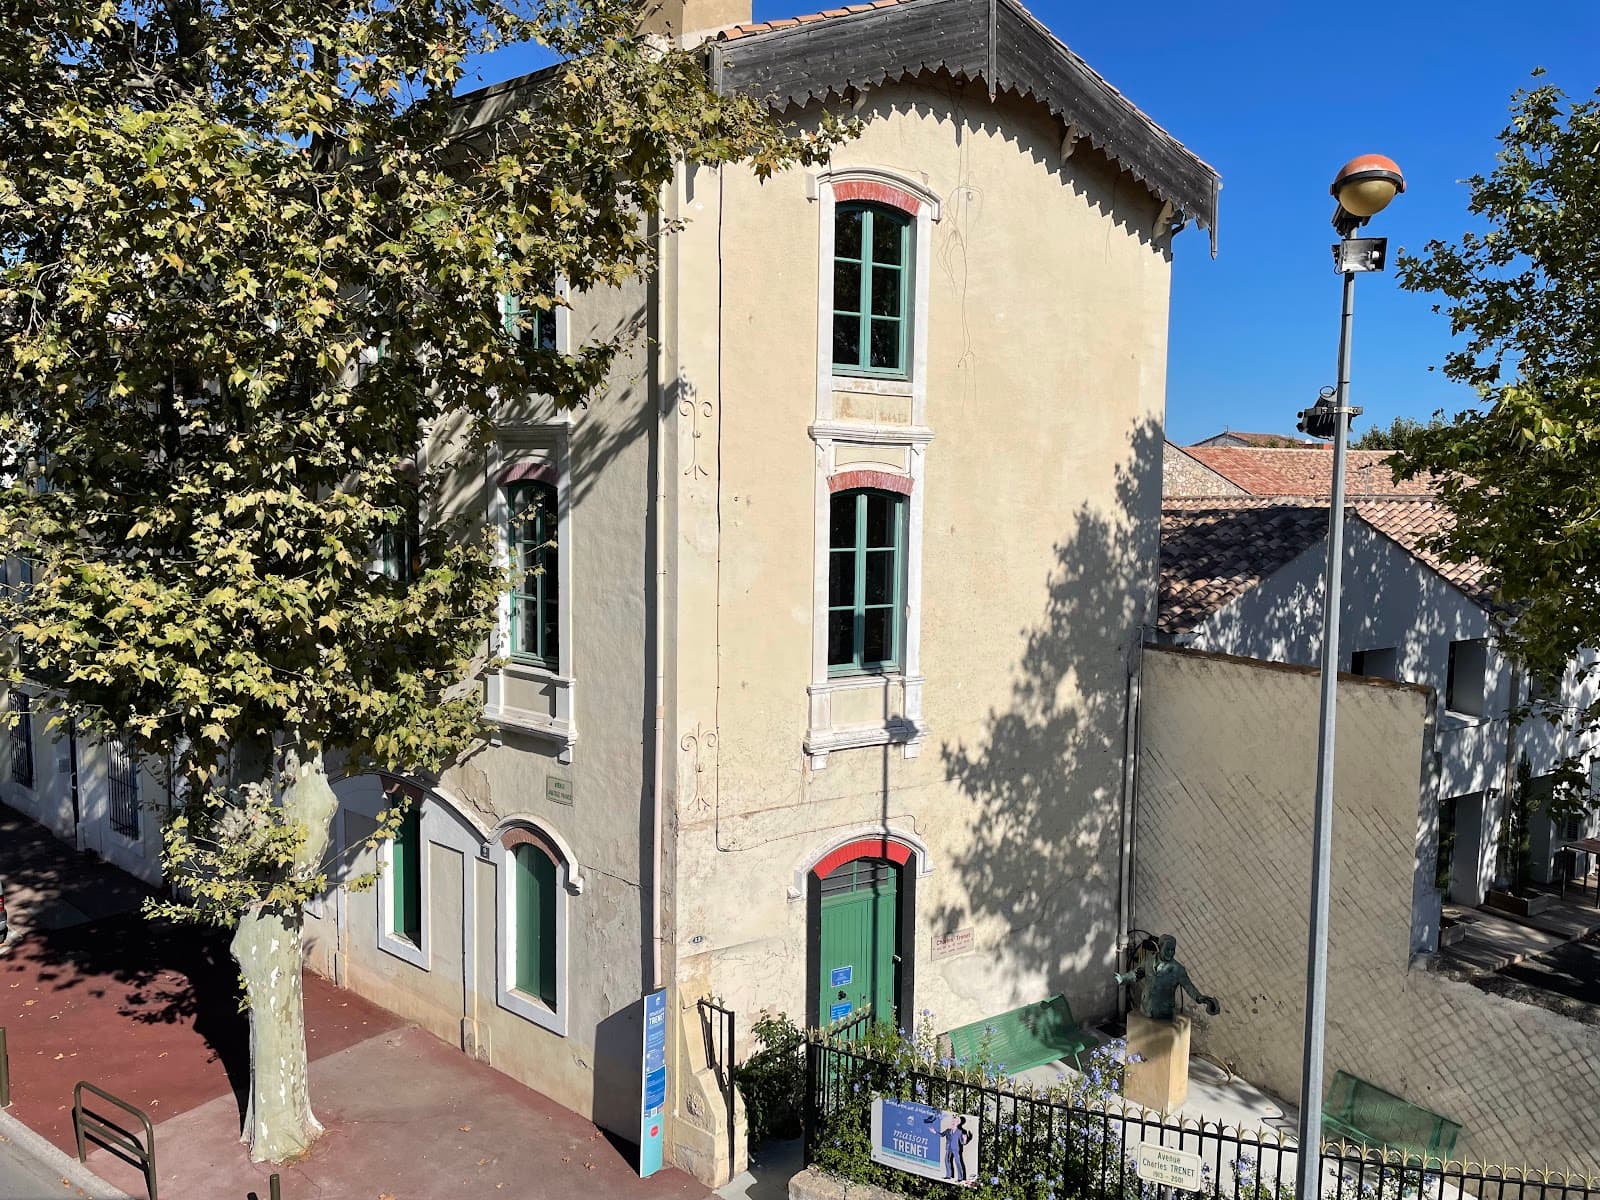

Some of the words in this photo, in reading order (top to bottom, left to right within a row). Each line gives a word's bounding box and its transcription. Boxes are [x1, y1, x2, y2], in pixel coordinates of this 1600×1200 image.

[649, 1012, 665, 1025] TRENET
[893, 1129, 929, 1145] maison
[893, 1138, 929, 1158] TRENET
[1157, 1151, 1181, 1164] Avenue
[1142, 1158, 1168, 1171] Charles
[1170, 1164, 1196, 1178] TRENET
